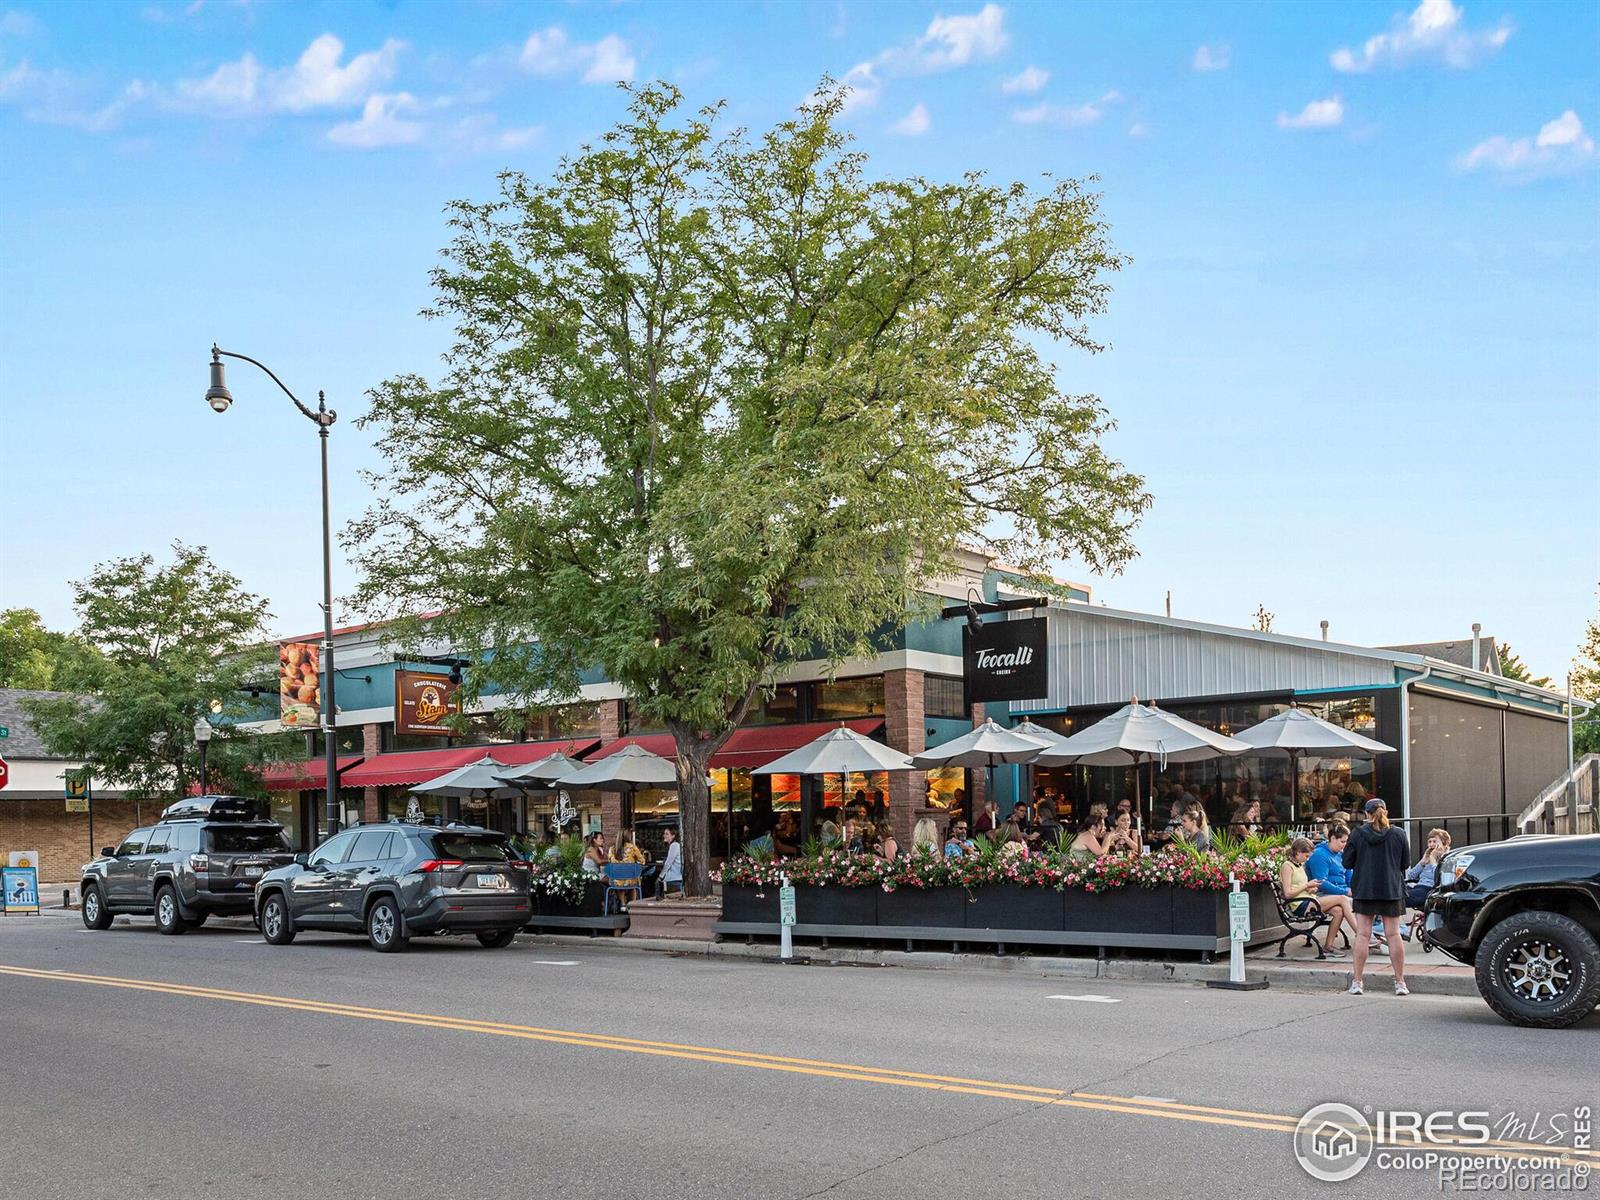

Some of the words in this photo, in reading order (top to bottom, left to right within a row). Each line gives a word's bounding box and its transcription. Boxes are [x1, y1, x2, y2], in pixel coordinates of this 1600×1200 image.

[975, 646, 1034, 669] Teocalli
[413, 680, 447, 690] CHOCOLATERIE
[416, 701, 448, 719] Stam
